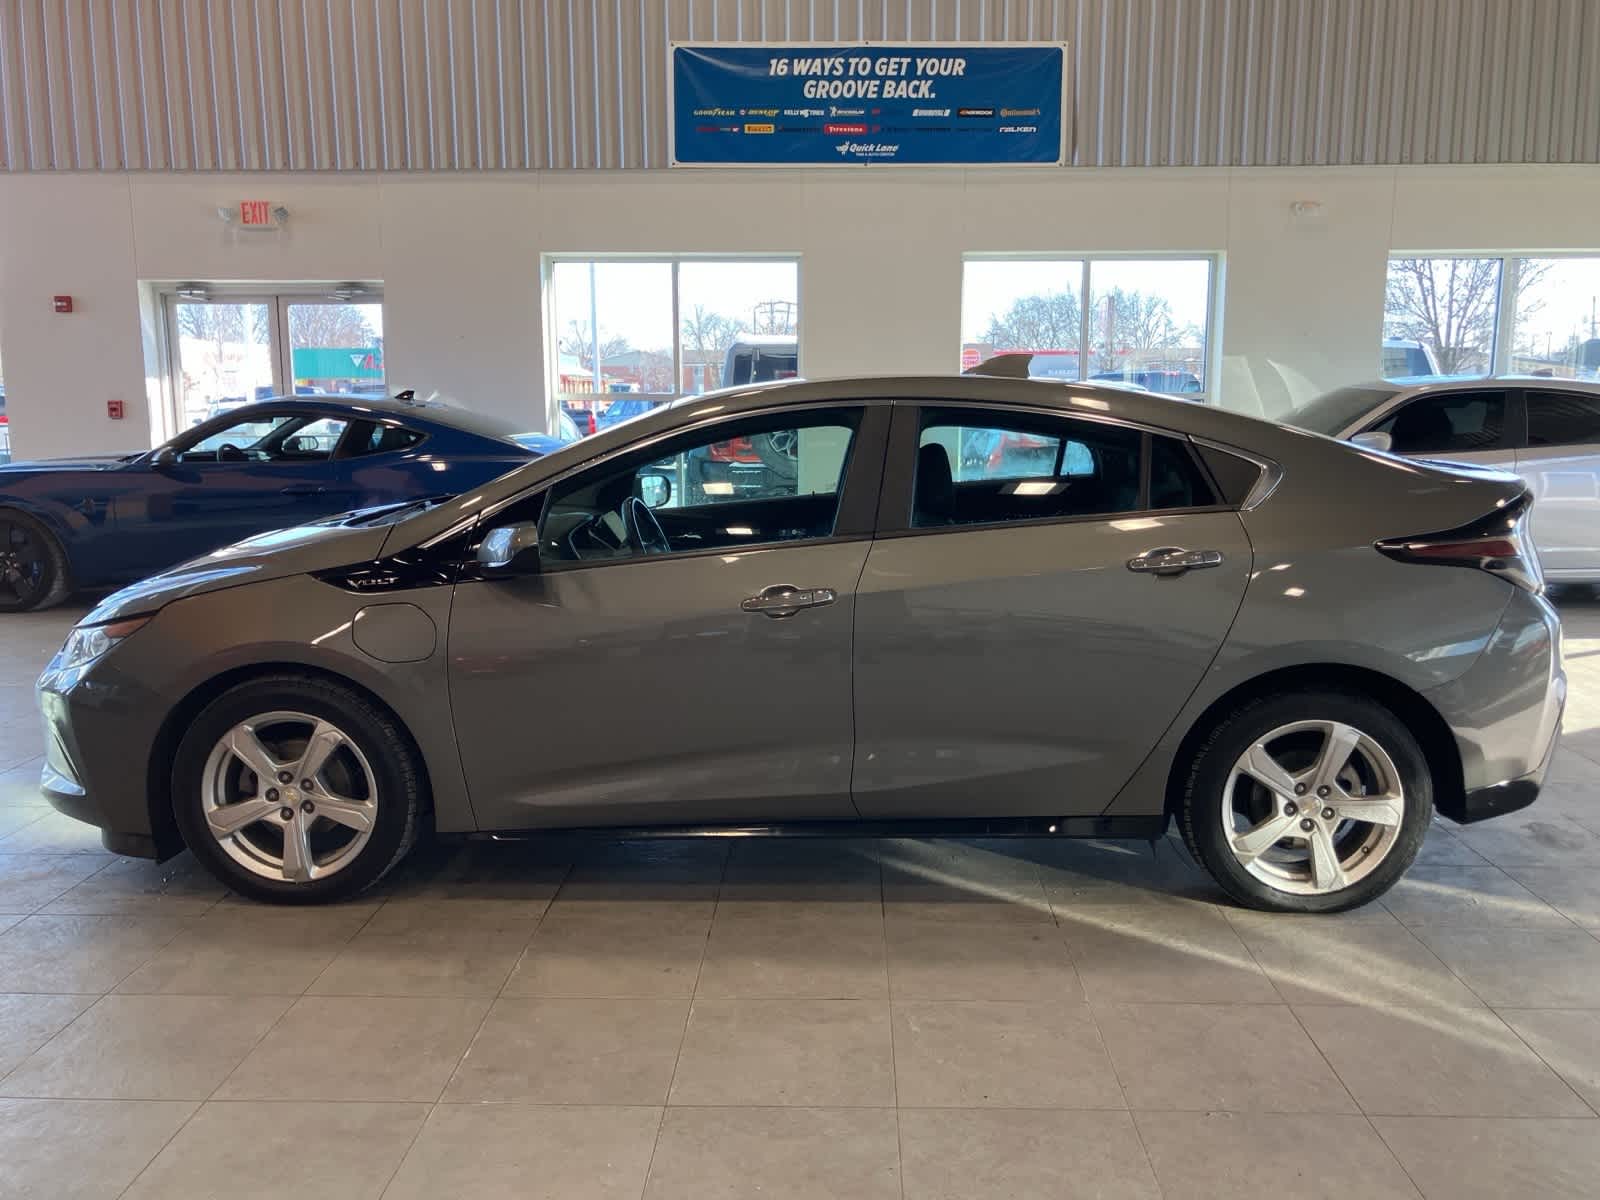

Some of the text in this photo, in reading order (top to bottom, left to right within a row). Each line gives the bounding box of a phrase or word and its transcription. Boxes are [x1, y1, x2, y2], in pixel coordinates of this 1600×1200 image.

[769, 58, 967, 76] 16 WAYS TO GET YOUR
[803, 79, 936, 99] GROOVE BACK.
[849, 143, 899, 153] Quick Lane
[240, 201, 269, 224] EXIT
